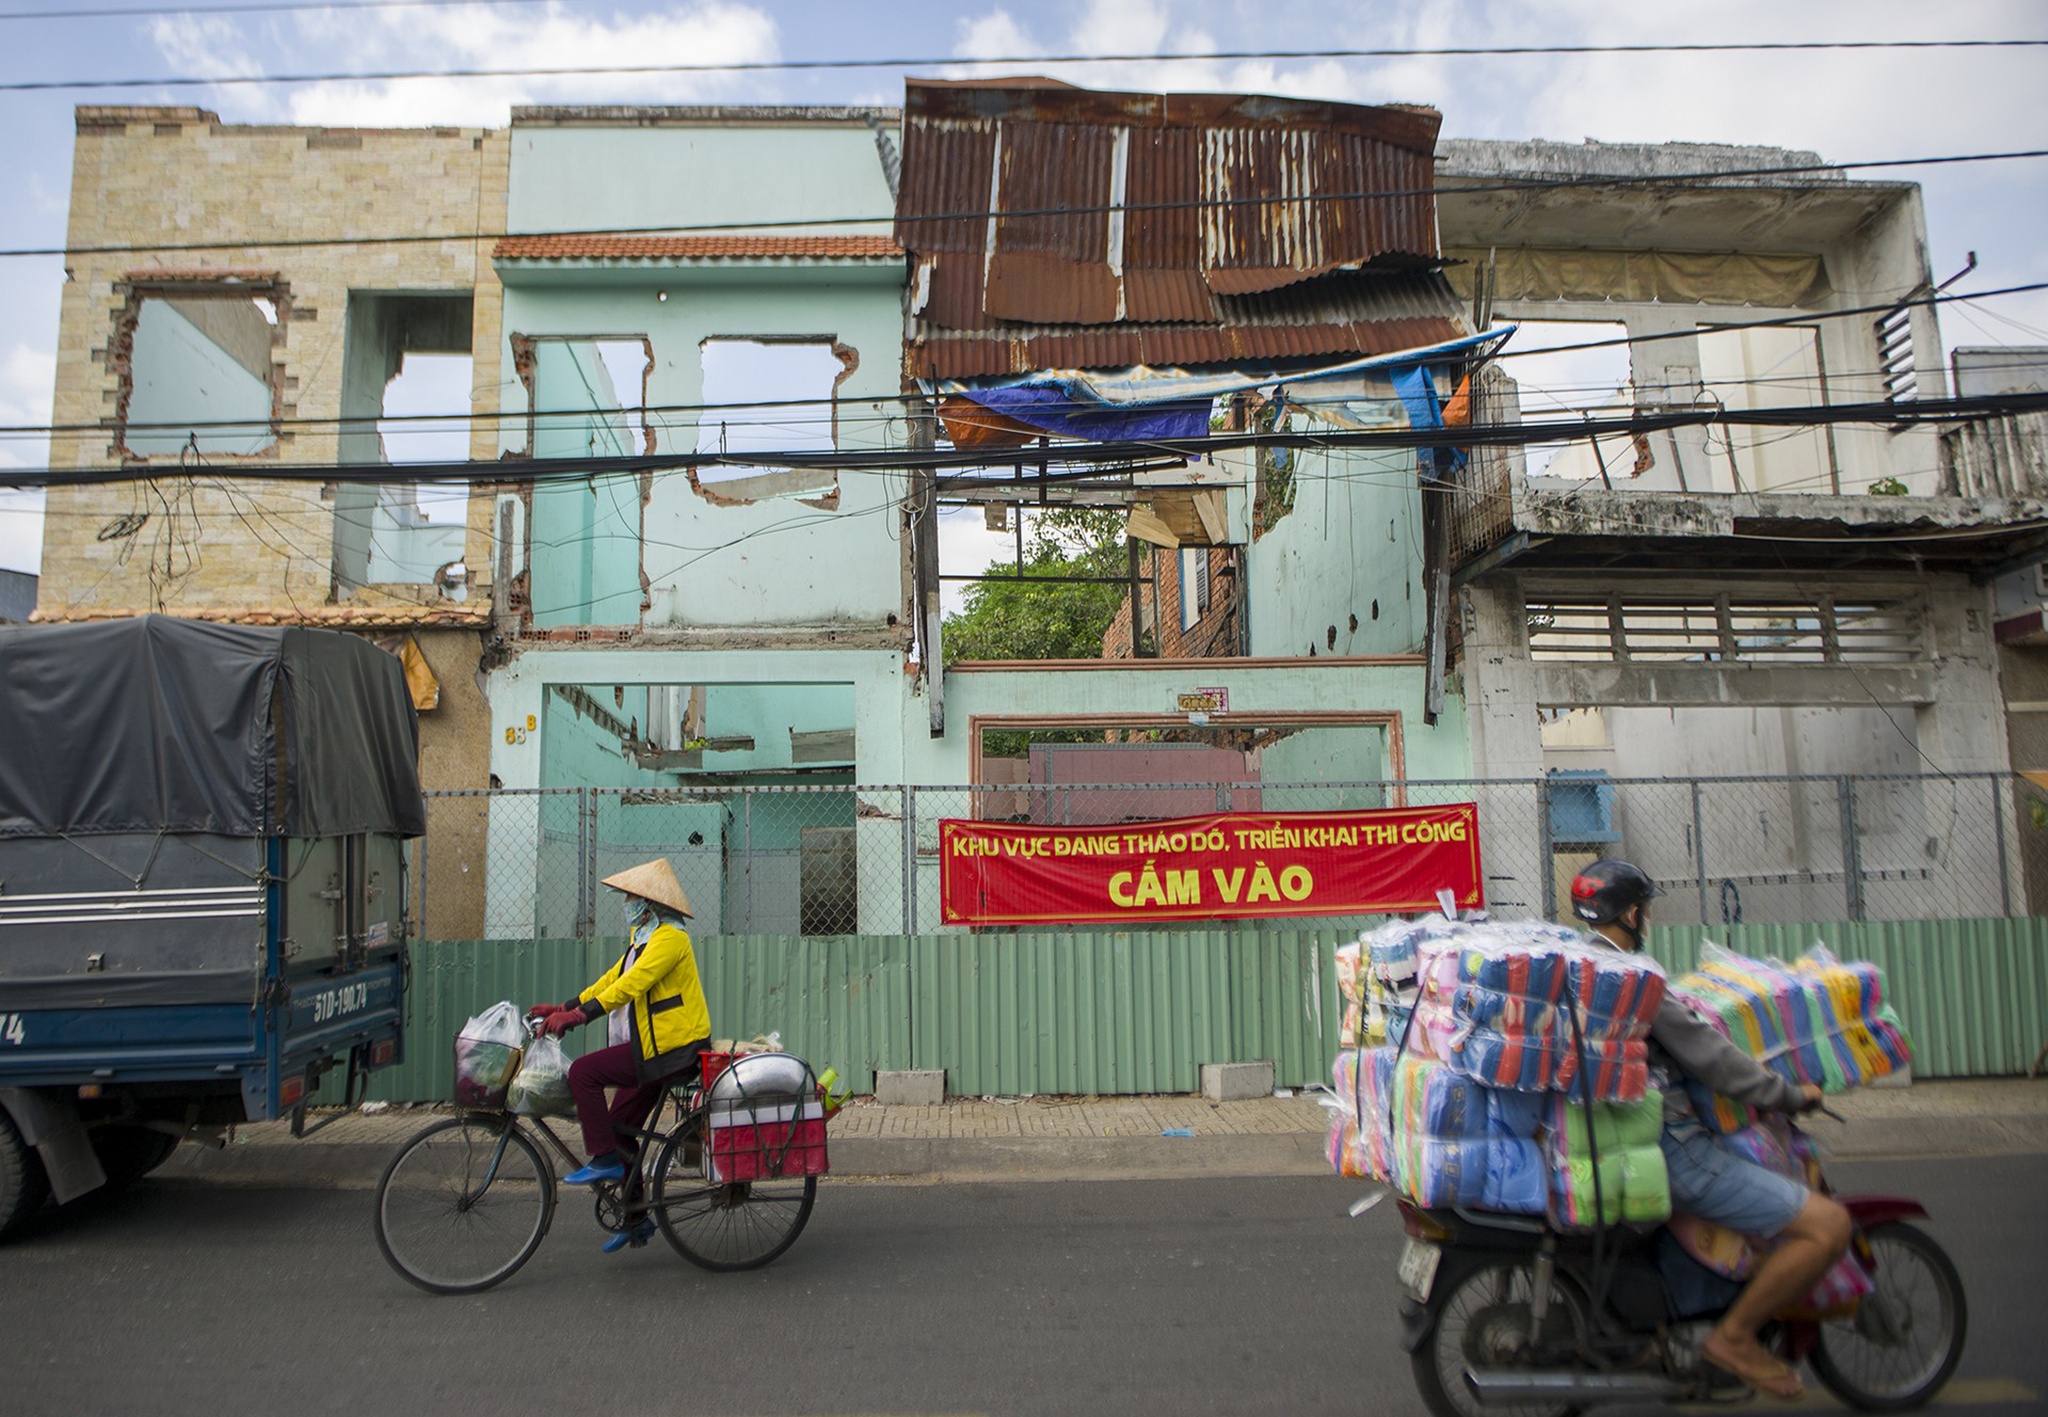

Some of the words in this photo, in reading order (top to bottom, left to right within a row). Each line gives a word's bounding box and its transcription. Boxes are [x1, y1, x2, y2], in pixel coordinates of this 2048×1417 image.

[953, 837, 999, 857] KHU
[1003, 836, 1051, 859] VỰC
[1054, 835, 1120, 856] ĐANG
[1122, 830, 1188, 854] THÁO
[1234, 821, 1301, 850] TRIỂN
[1303, 826, 1358, 848] KHAI
[1361, 825, 1398, 845] THI
[1401, 819, 1466, 844] CÔNG
[1108, 859, 1201, 907] CẤM
[1212, 860, 1314, 903] VÀO
